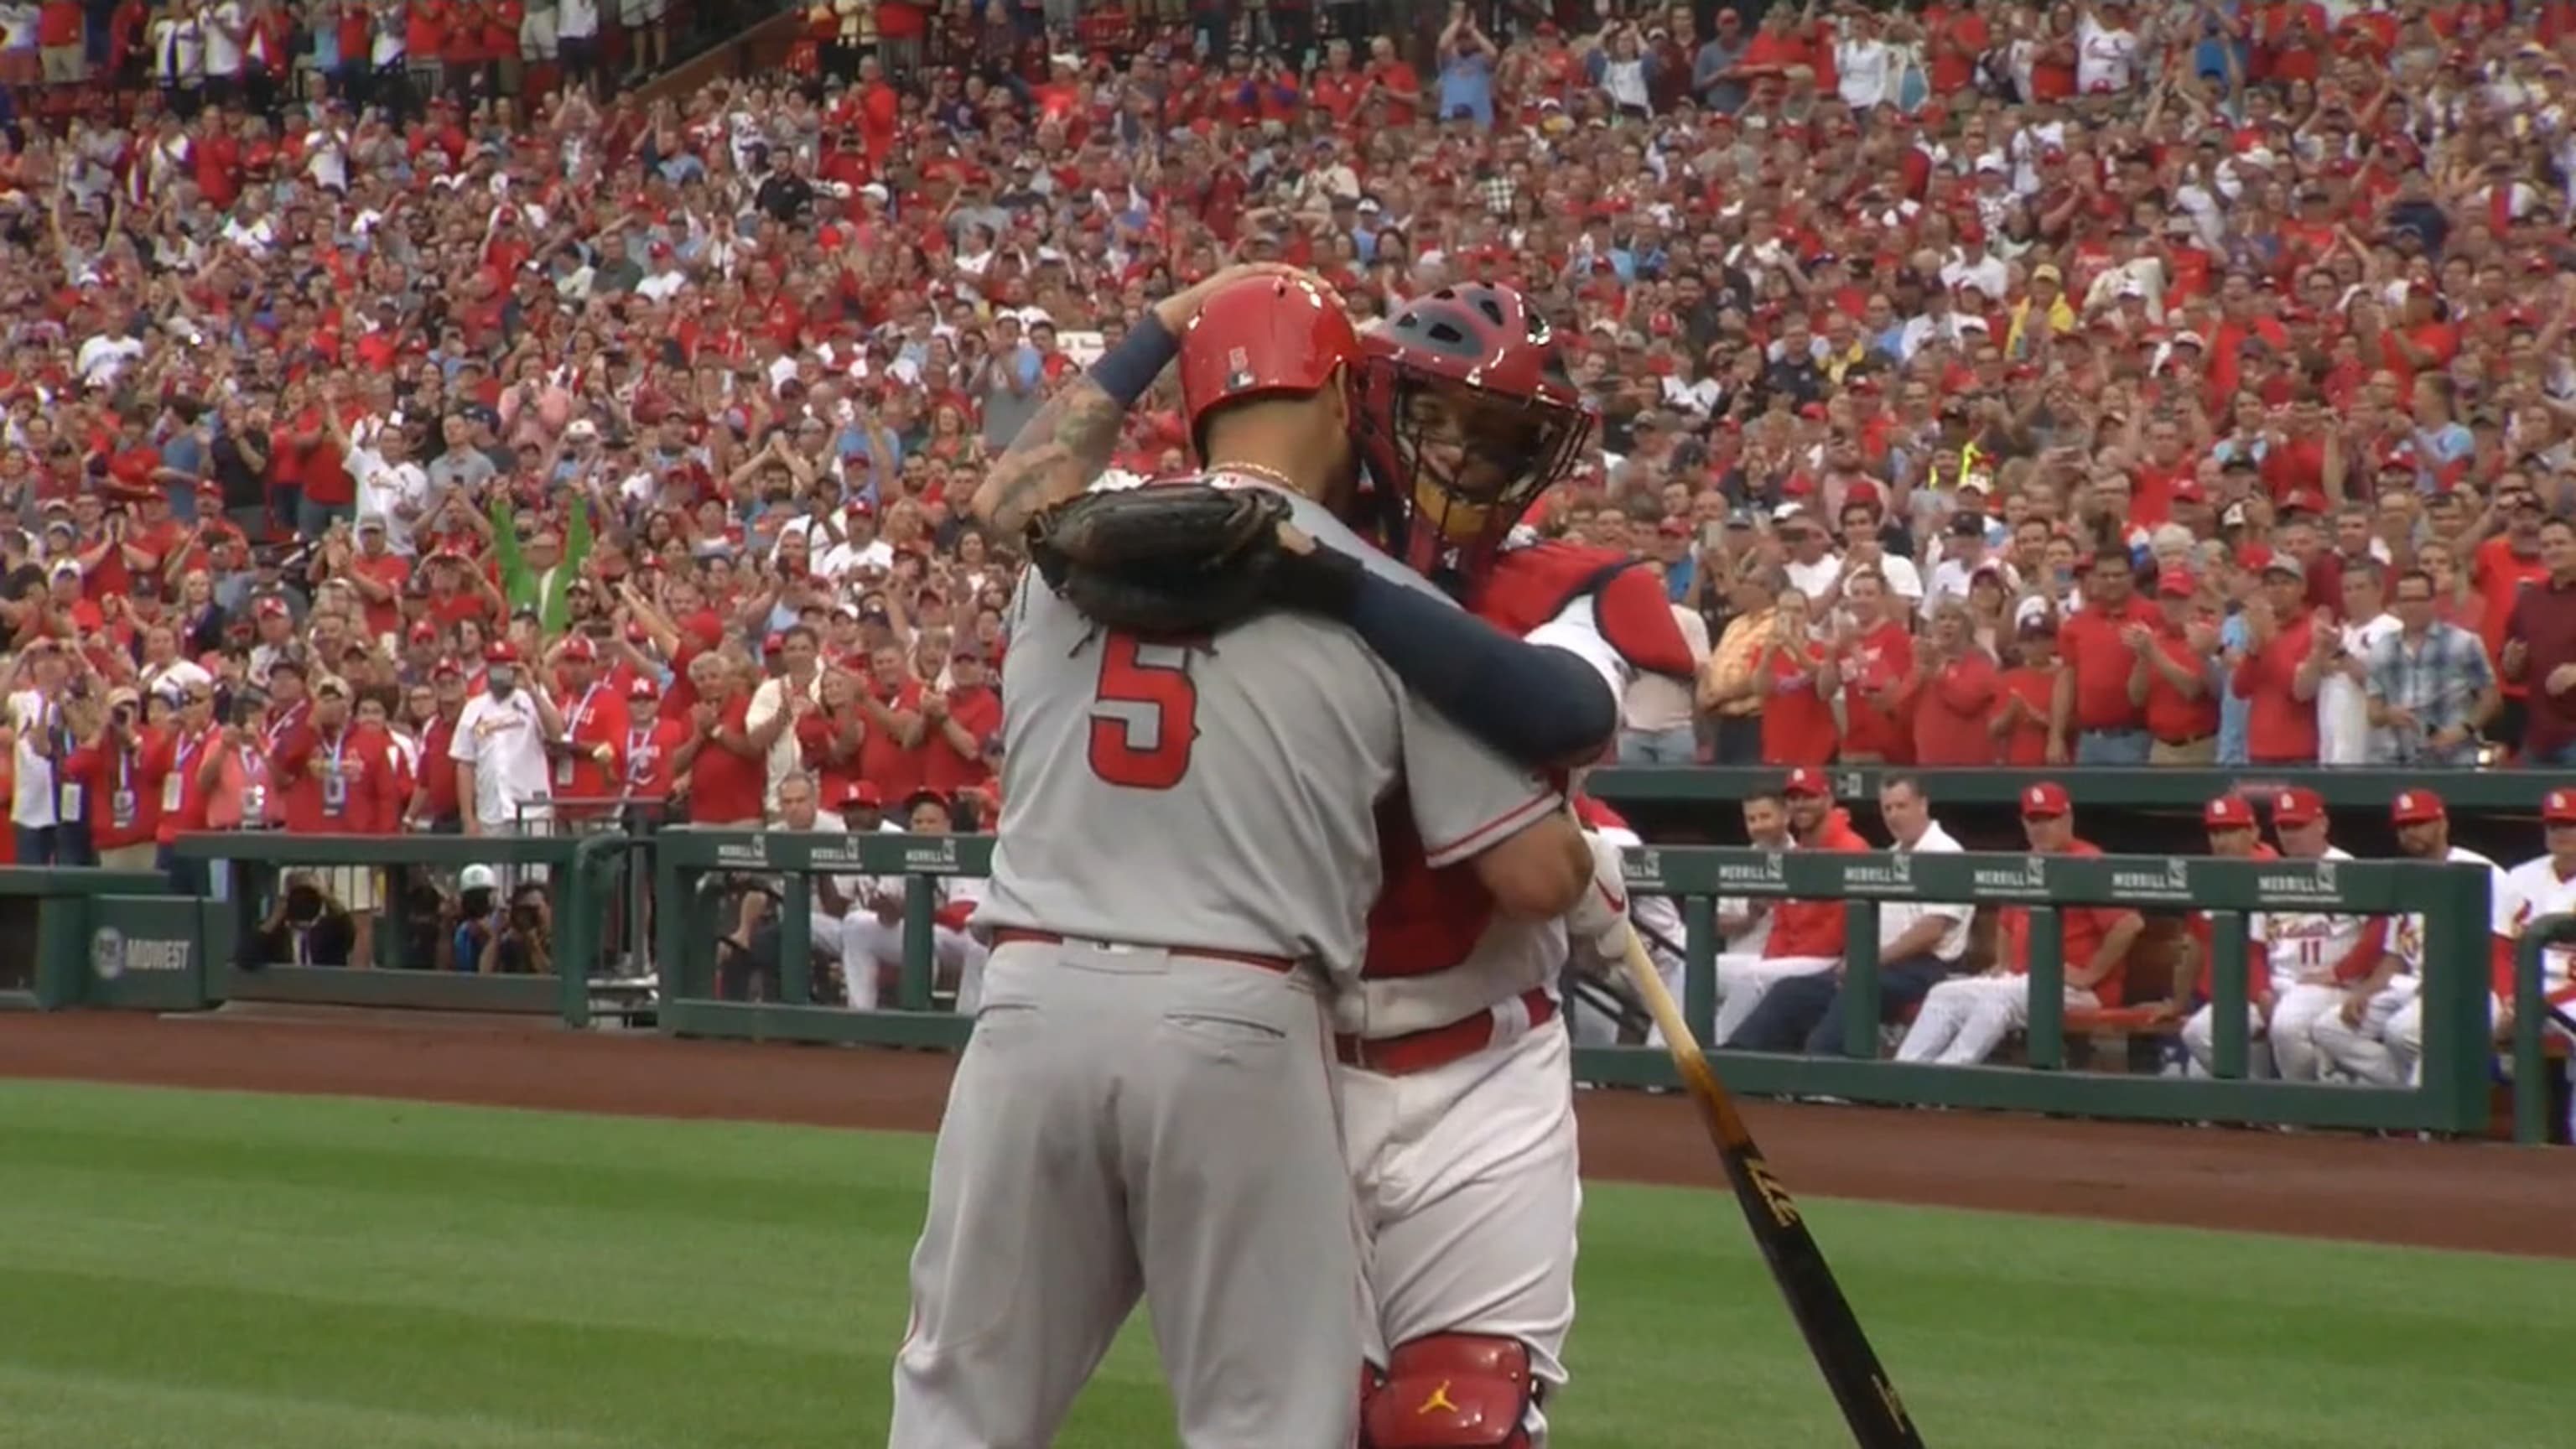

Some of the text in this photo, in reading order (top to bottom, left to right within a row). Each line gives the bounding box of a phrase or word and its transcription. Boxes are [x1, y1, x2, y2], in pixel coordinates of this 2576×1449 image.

[1088, 629, 1197, 790] 5
[1719, 865, 1766, 880] MERRILL
[1844, 866, 1893, 881] MERRILL
[1974, 870, 2025, 886] MERRILL
[2112, 872, 2168, 889] MERRILL
[2259, 875, 2315, 892] MERRILL
[125, 937, 191, 970] MIDWEST
[2300, 940, 2320, 966] 11
